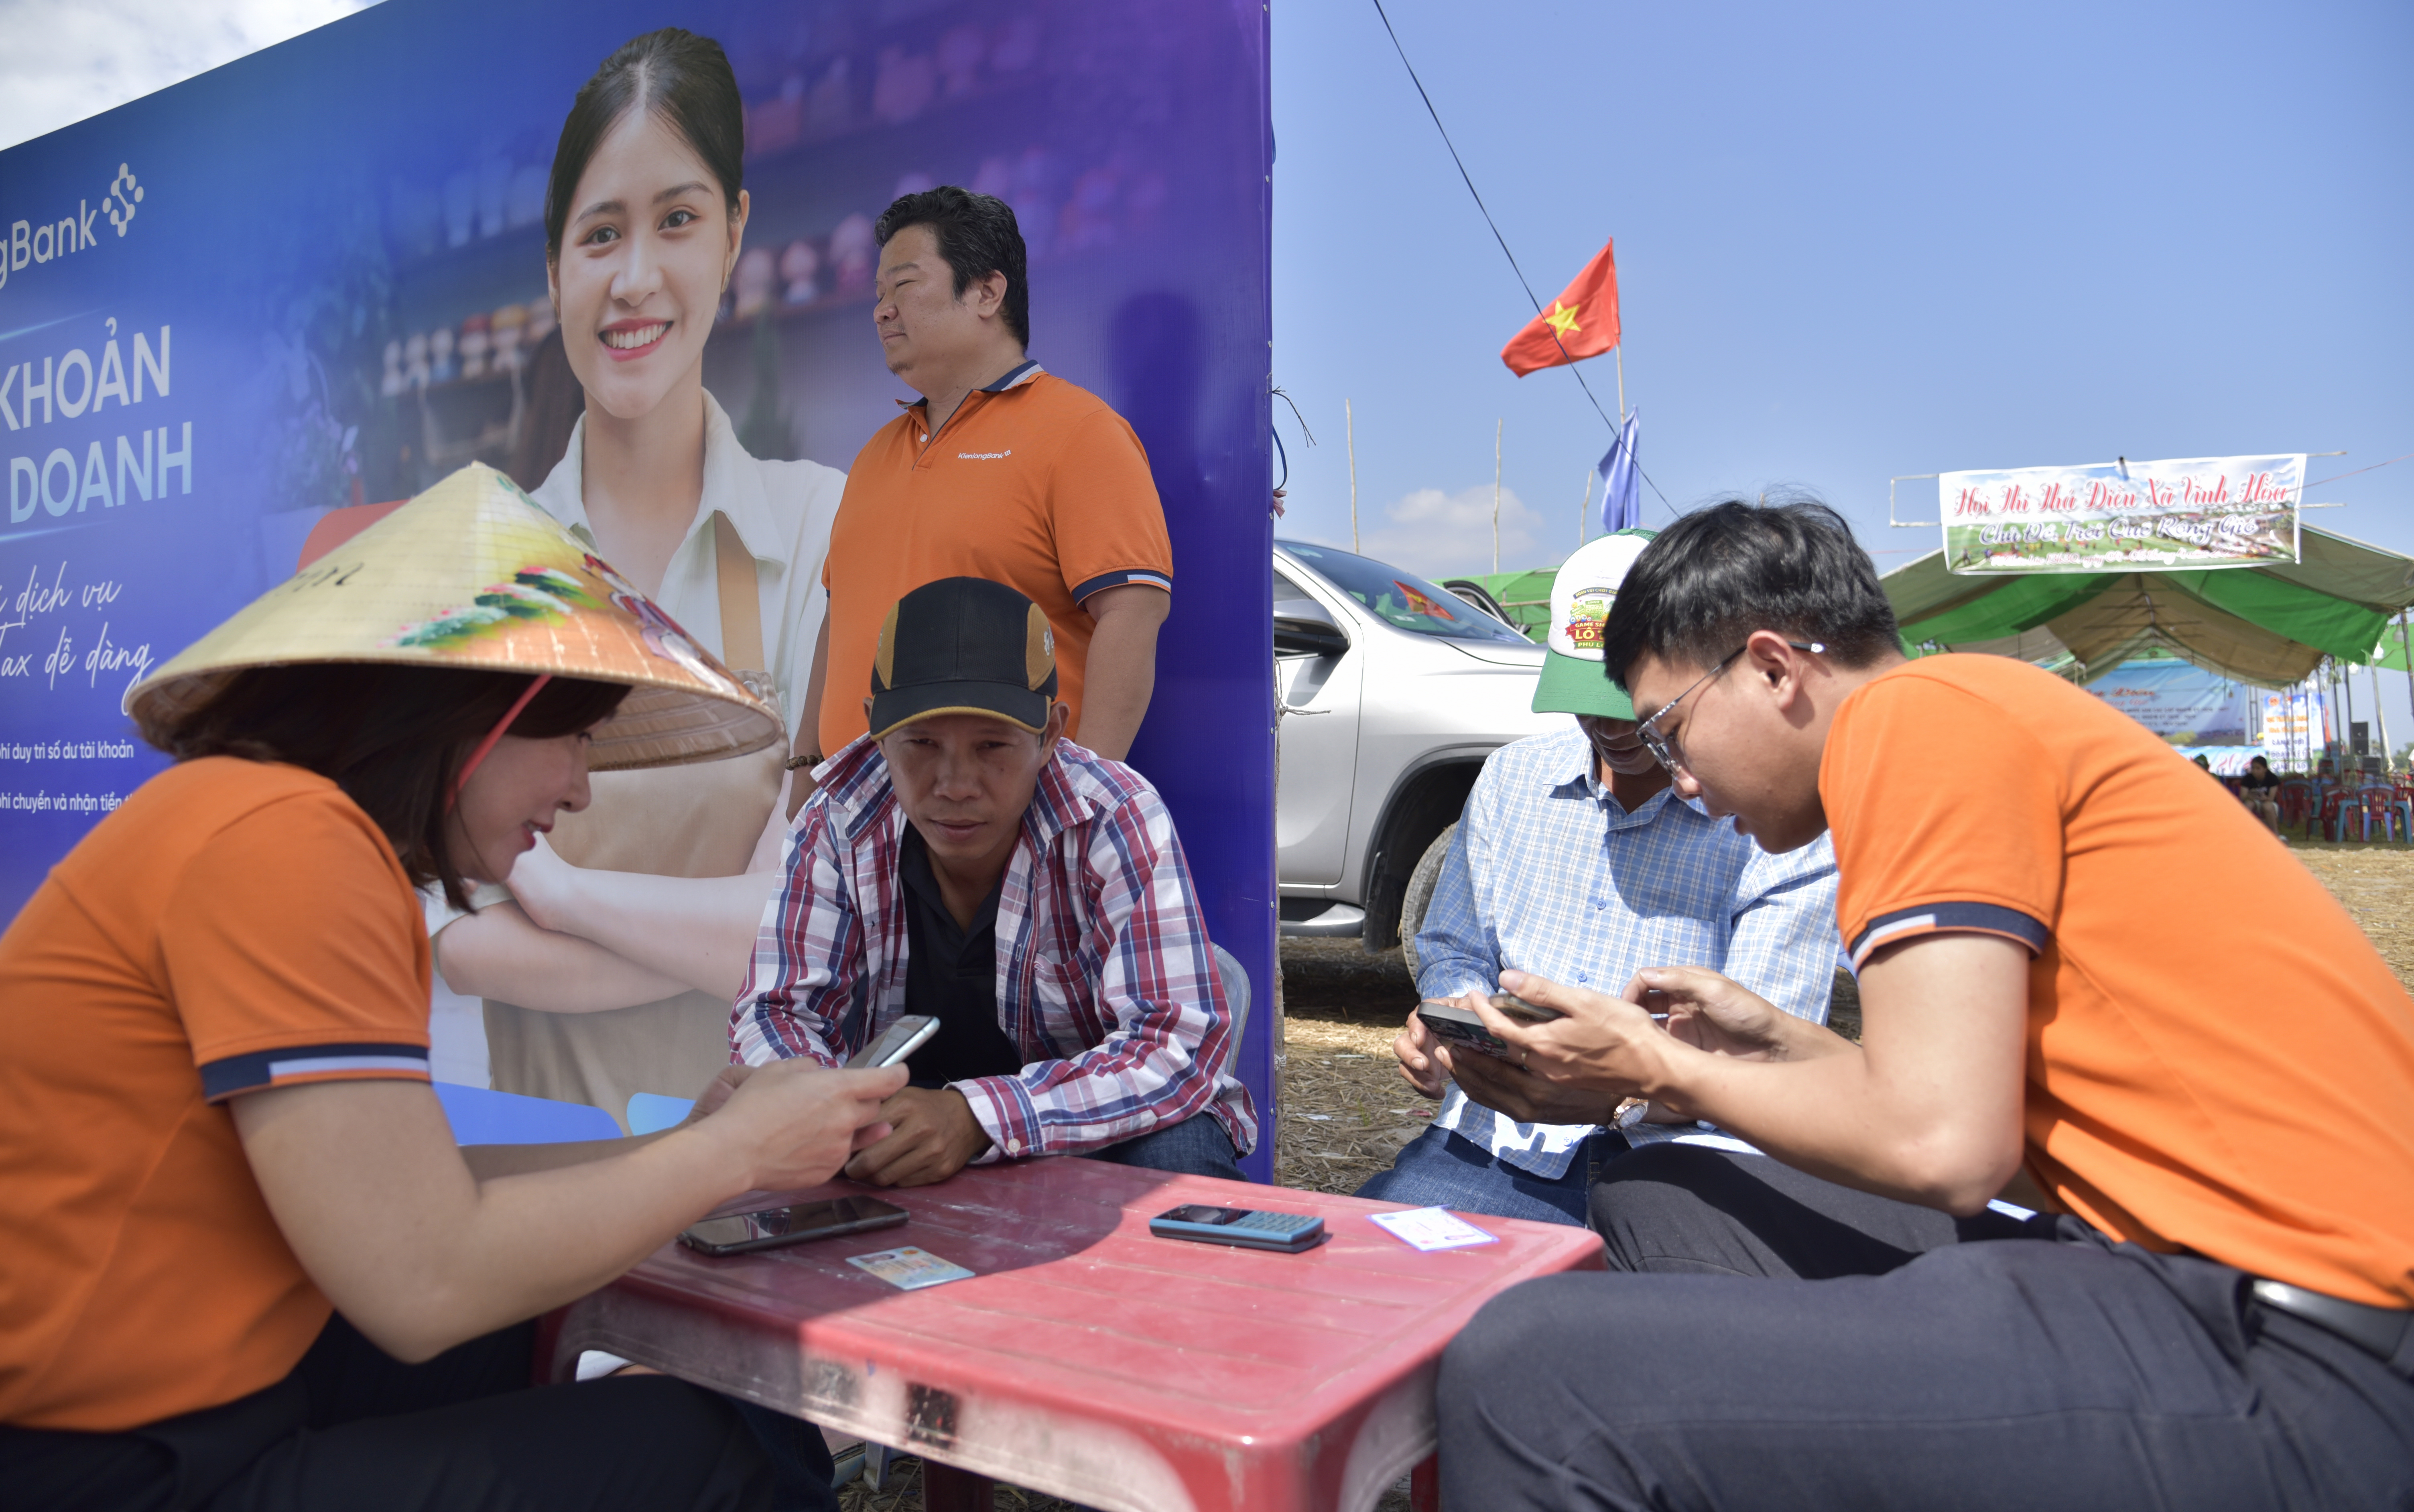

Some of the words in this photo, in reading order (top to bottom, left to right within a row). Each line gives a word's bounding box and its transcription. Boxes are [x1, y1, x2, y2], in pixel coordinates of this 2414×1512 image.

[0, 316, 170, 431] KHOẢN
[10, 421, 192, 524] DOANH
[1998, 483, 2030, 513] Thi
[2180, 475, 2229, 506] Vĩnh
[2236, 471, 2288, 504] Hòa
[16, 561, 73, 629] dịch
[82, 580, 122, 612] vụ
[1575, 627, 1595, 639] LÔ
[45, 626, 77, 691] dễ
[85, 622, 154, 716] dàng
[0, 743, 10, 759] hí
[12, 743, 32, 763] duy
[34, 742, 45, 759] trì
[48, 740, 61, 759] số
[63, 742, 78, 759] dư
[79, 741, 95, 758] tài
[98, 739, 134, 758] khoản
[0, 792, 11, 809] hí
[13, 790, 51, 814] chuyển
[53, 793, 67, 810] và
[70, 793, 98, 816] nhận
